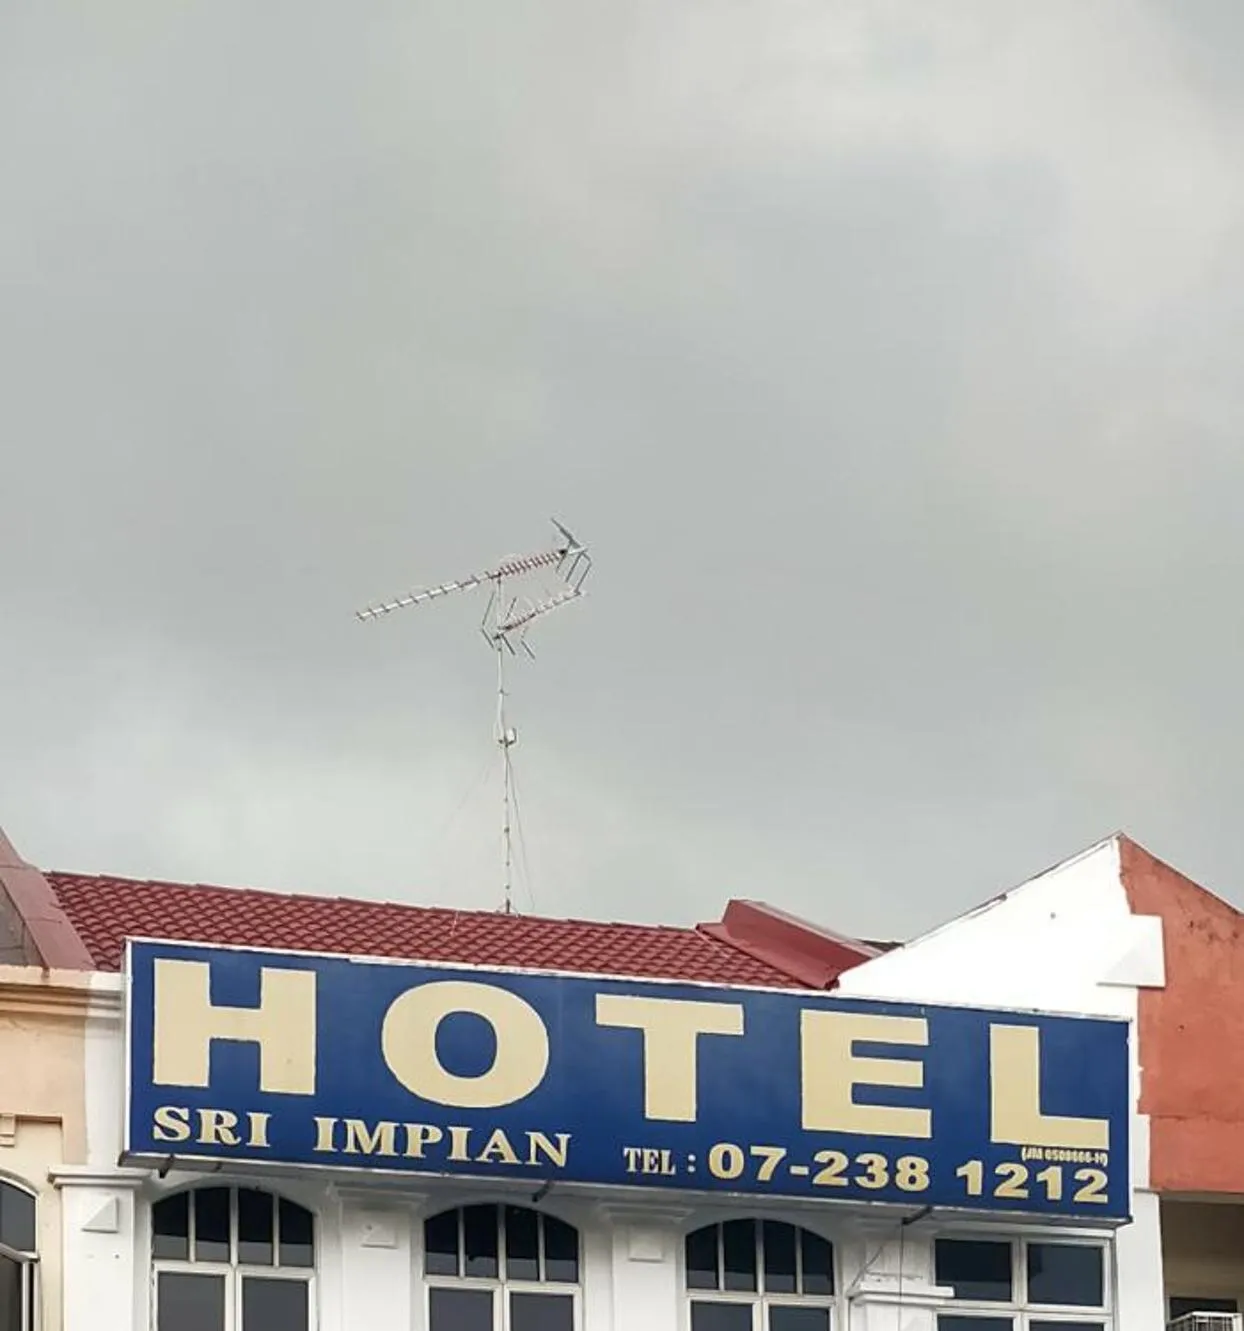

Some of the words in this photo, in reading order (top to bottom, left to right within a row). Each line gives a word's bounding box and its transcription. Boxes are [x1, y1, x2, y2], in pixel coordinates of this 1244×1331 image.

[153, 957, 1110, 1151] HOTEL
[152, 1106, 272, 1148] SRI
[313, 1117, 571, 1168] IMPIAN
[708, 1143, 931, 1192] 07-238
[956, 1159, 1109, 1204] 1212
